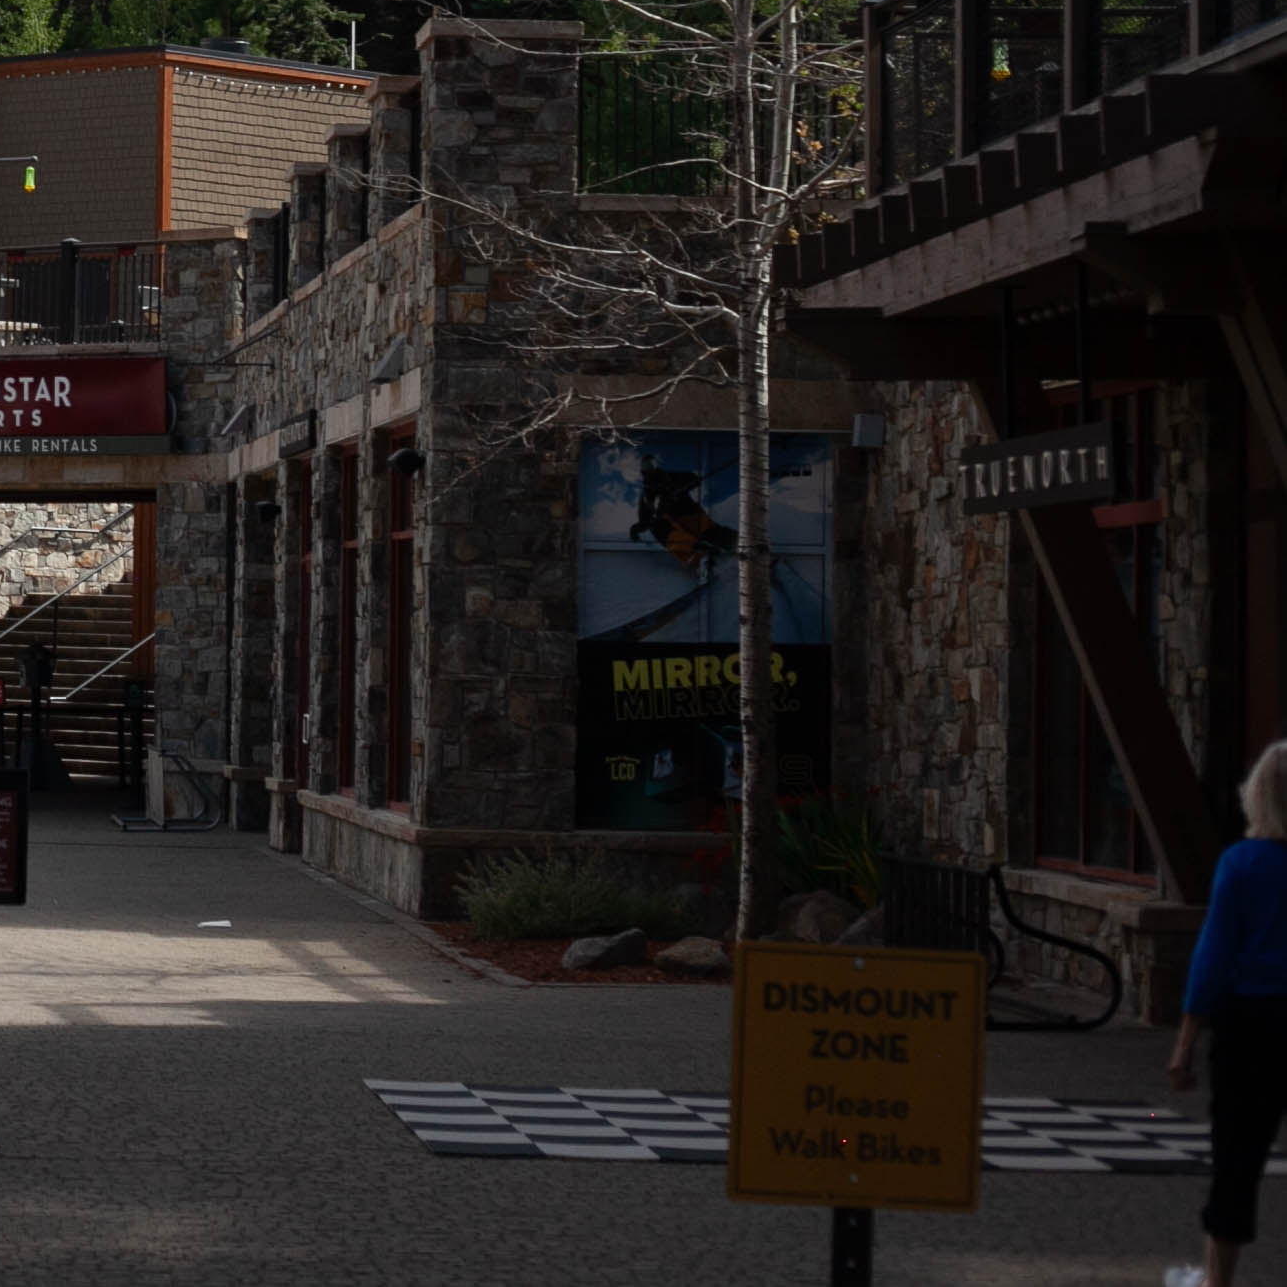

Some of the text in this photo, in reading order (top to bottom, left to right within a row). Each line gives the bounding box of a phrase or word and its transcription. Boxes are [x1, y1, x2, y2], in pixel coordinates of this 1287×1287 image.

[31, 438, 98, 453] RENTALS
[762, 981, 959, 1021] DISMOUNT
[810, 1029, 910, 1064] ZONE
[805, 1084, 910, 1120] Please
[769, 1126, 943, 1166] Walk Bikes
